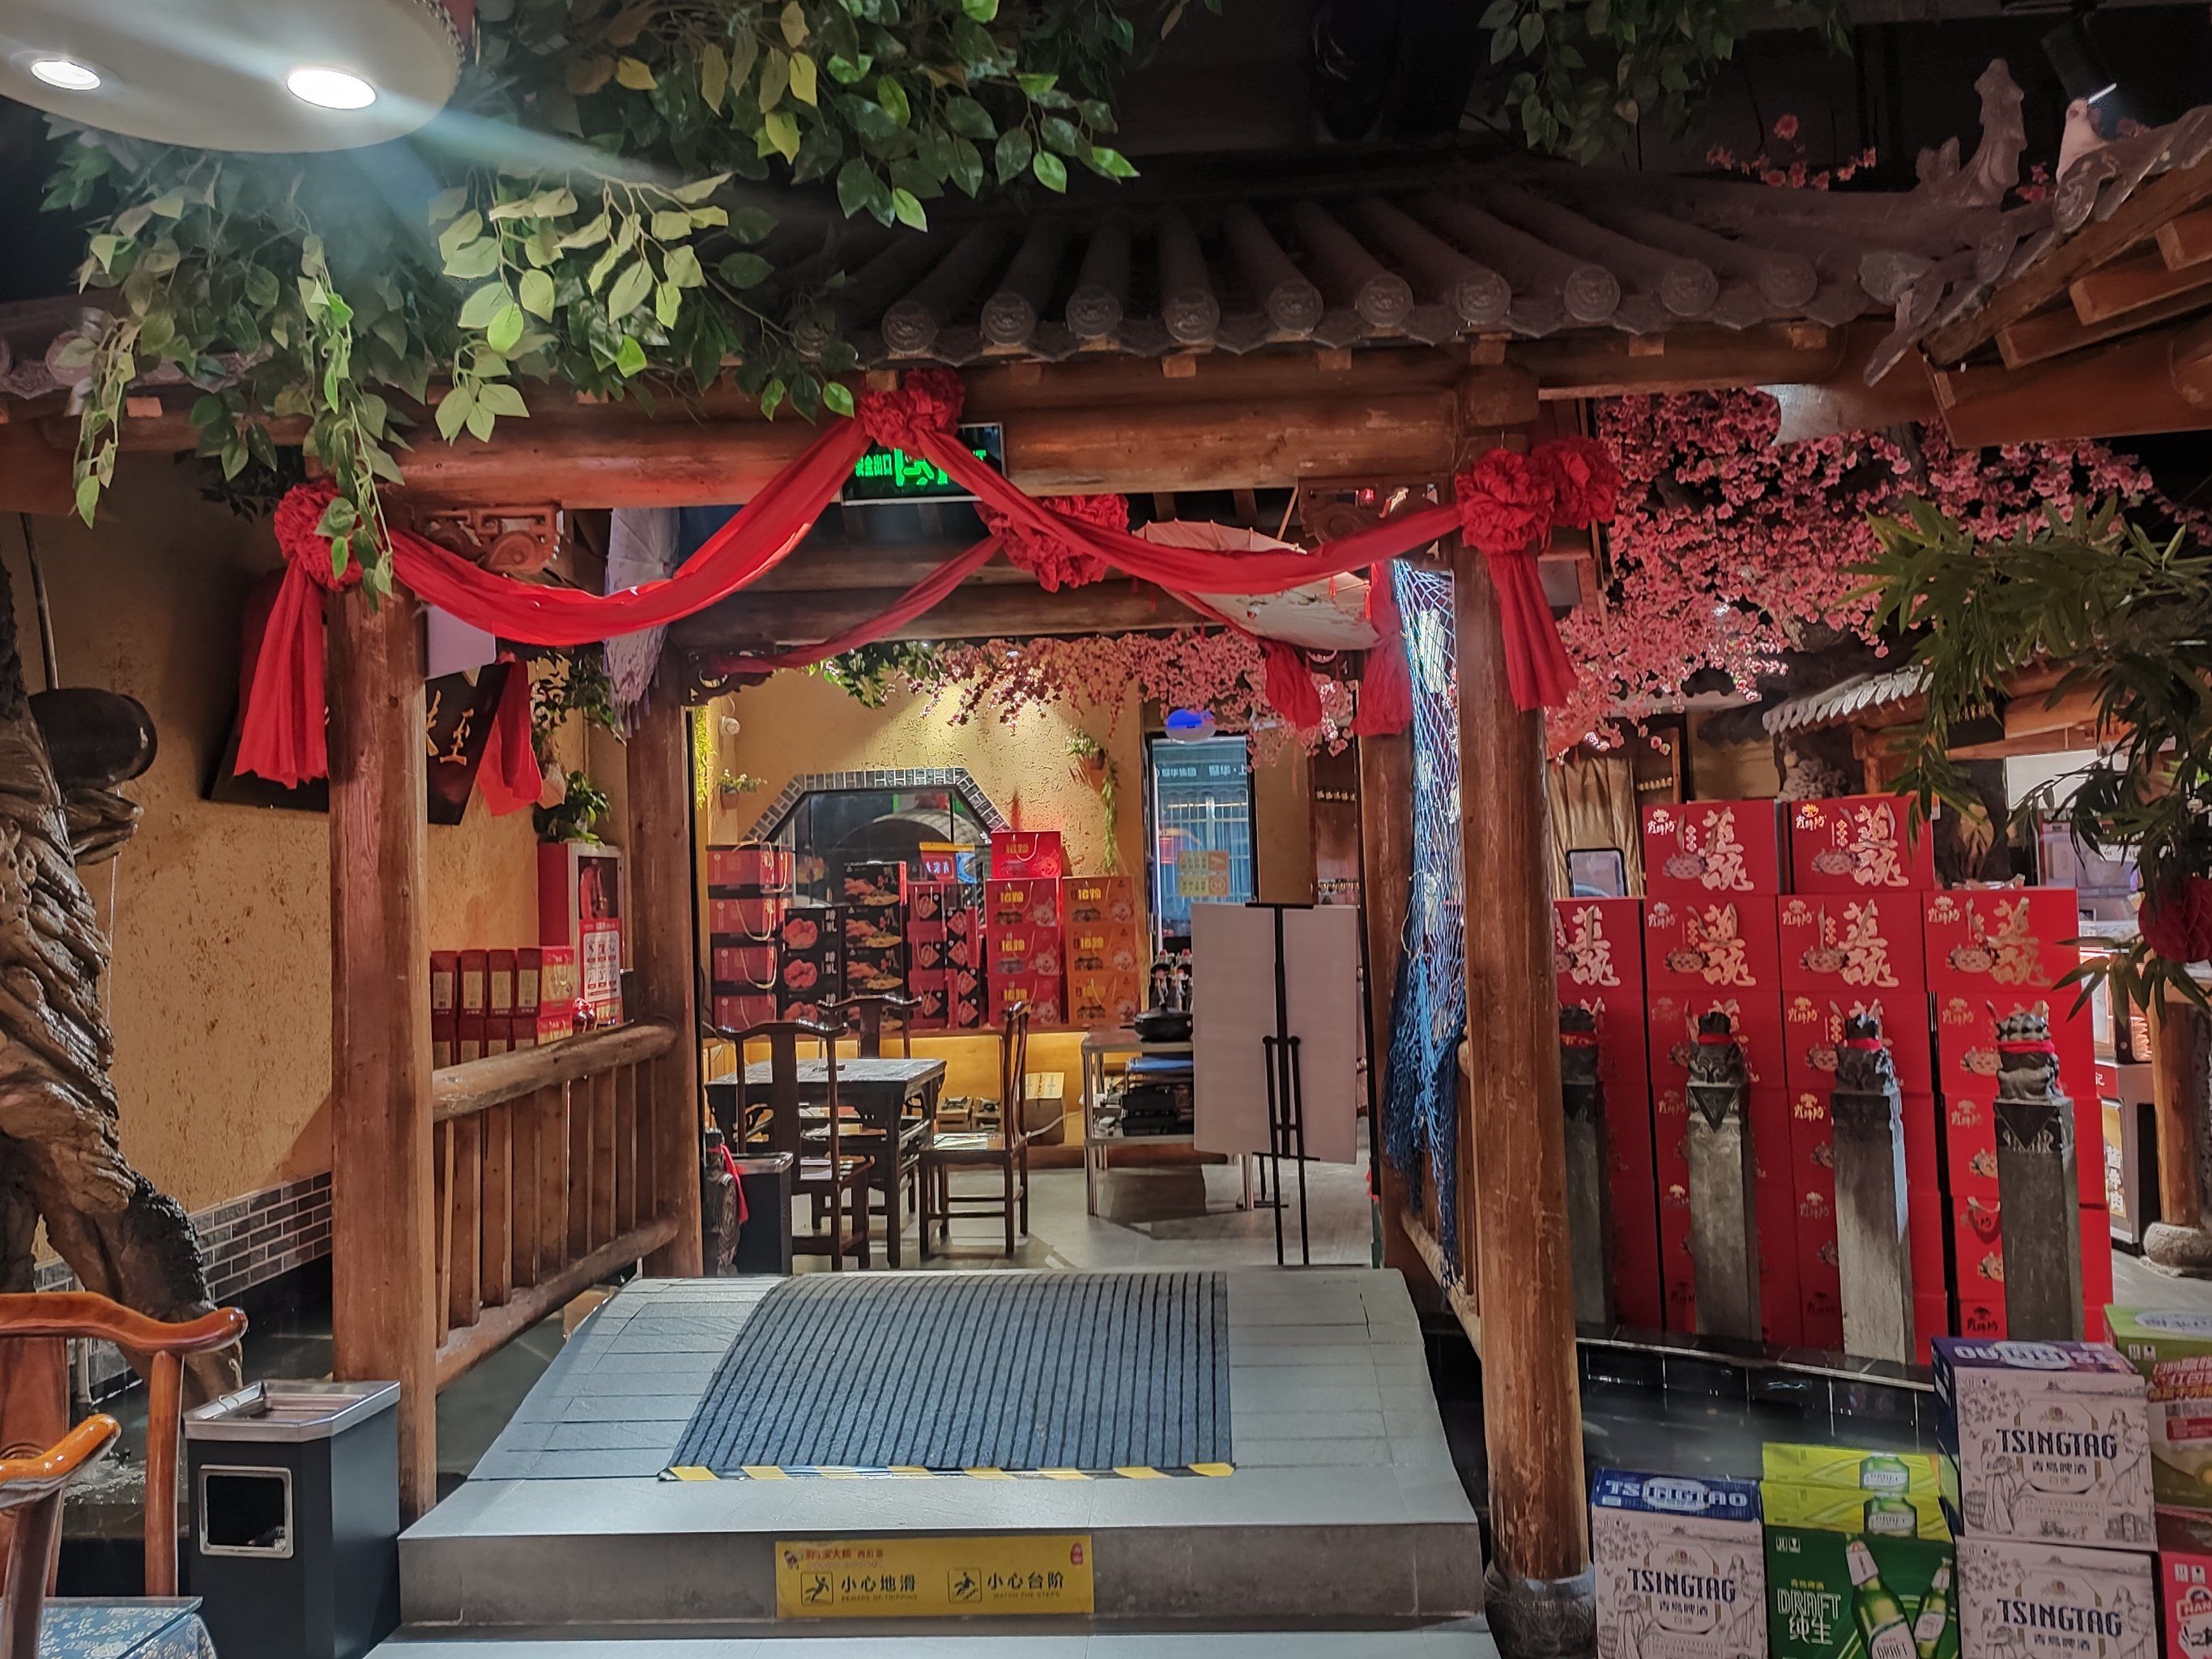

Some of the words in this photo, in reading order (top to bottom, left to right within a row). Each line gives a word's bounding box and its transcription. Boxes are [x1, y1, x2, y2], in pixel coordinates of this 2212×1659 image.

[841, 1573, 916, 1593] 小心地滑
[987, 1571, 1064, 1591] 小心台阶
[993, 1592, 1018, 1600] WATCH
[1777, 1588, 1842, 1620] DRAFT
[1788, 1614, 1834, 1646] 纯生
